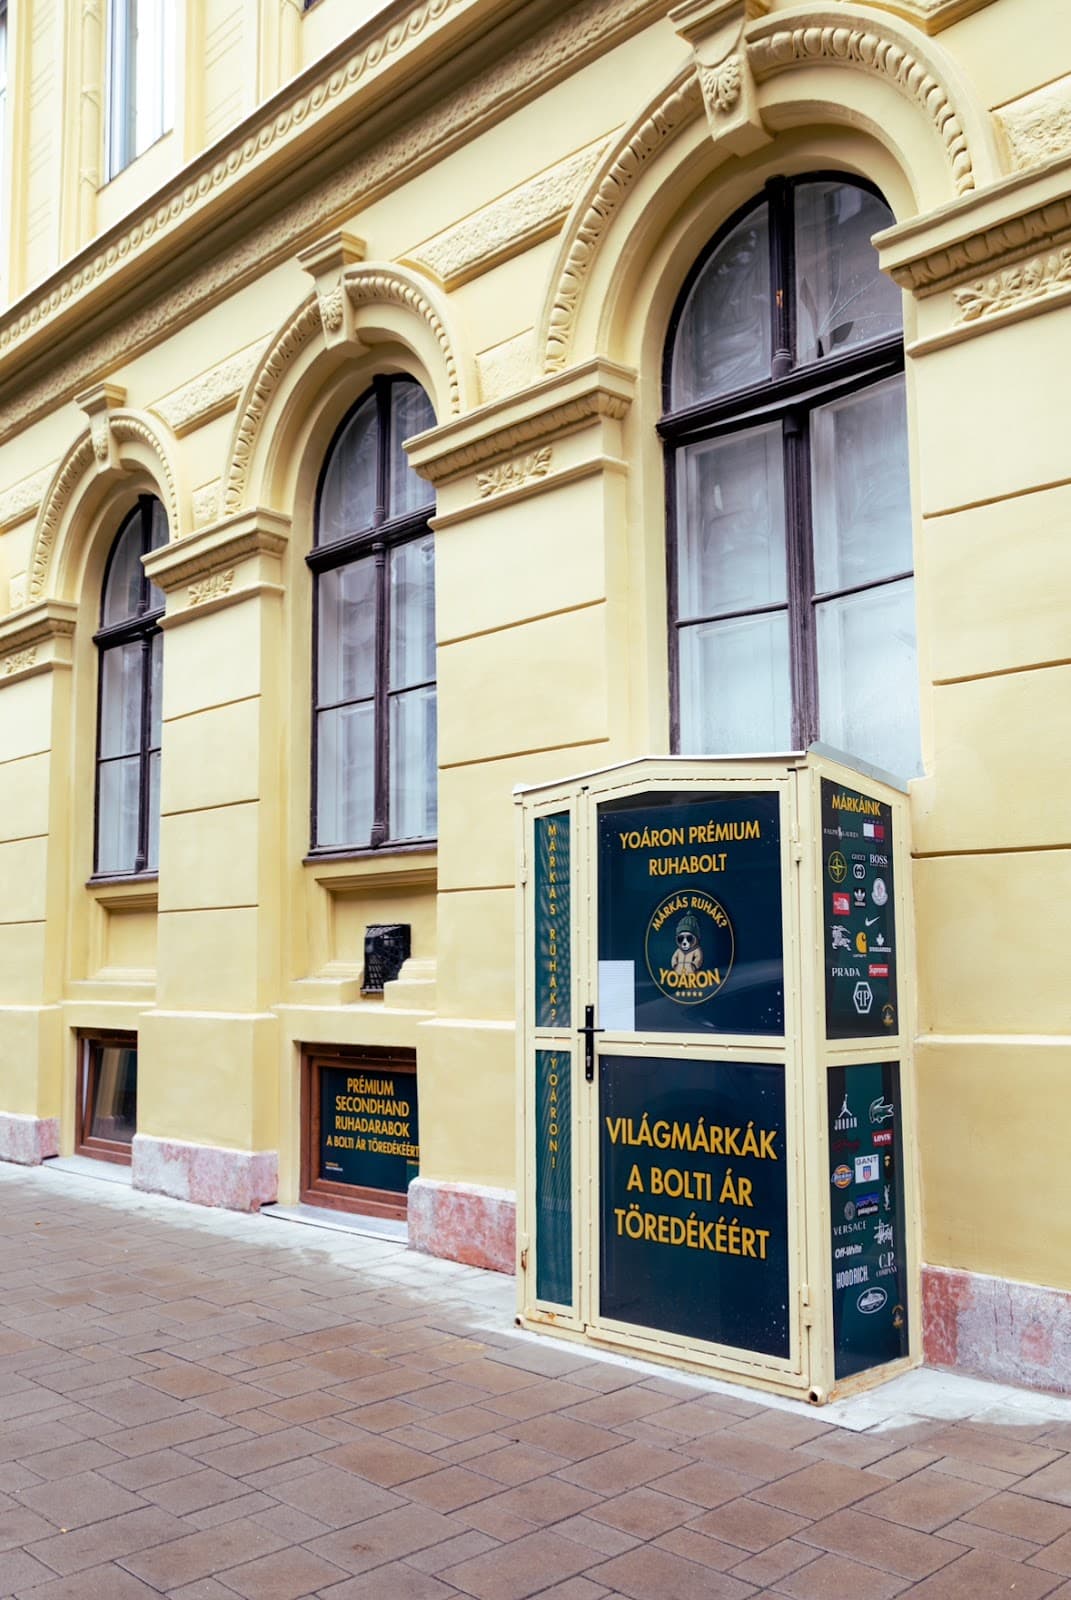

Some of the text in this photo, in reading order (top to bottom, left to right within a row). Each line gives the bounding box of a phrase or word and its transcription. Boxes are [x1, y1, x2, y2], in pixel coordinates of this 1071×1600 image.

[832, 793, 881, 816] MÁRKÁINK
[620, 820, 760, 849] YOÁRON PRÉMIUM
[649, 853, 727, 876] RUHABOLT
[870, 854, 888, 864] BOSS
[652, 896, 728, 931] MÁRKÁS RUHÁK?
[659, 967, 721, 988] YOÁRON
[831, 967, 861, 977] PRADA
[347, 1075, 394, 1096] PRÉMIUM
[335, 1095, 409, 1117] SECONDHAND
[335, 1115, 410, 1137] RUHADARABOK
[606, 1112, 778, 1160] VILÁGMÁRKÁK
[326, 1135, 333, 1146] A
[334, 1136, 354, 1149] BOLTI
[355, 1136, 366, 1151] ÁR
[856, 1156, 878, 1166] GANT
[626, 1164, 754, 1207] A BOLTI ÁR
[614, 1203, 770, 1259] TÖREDÉKÉÉRT
[833, 1220, 866, 1236] VERSACE
